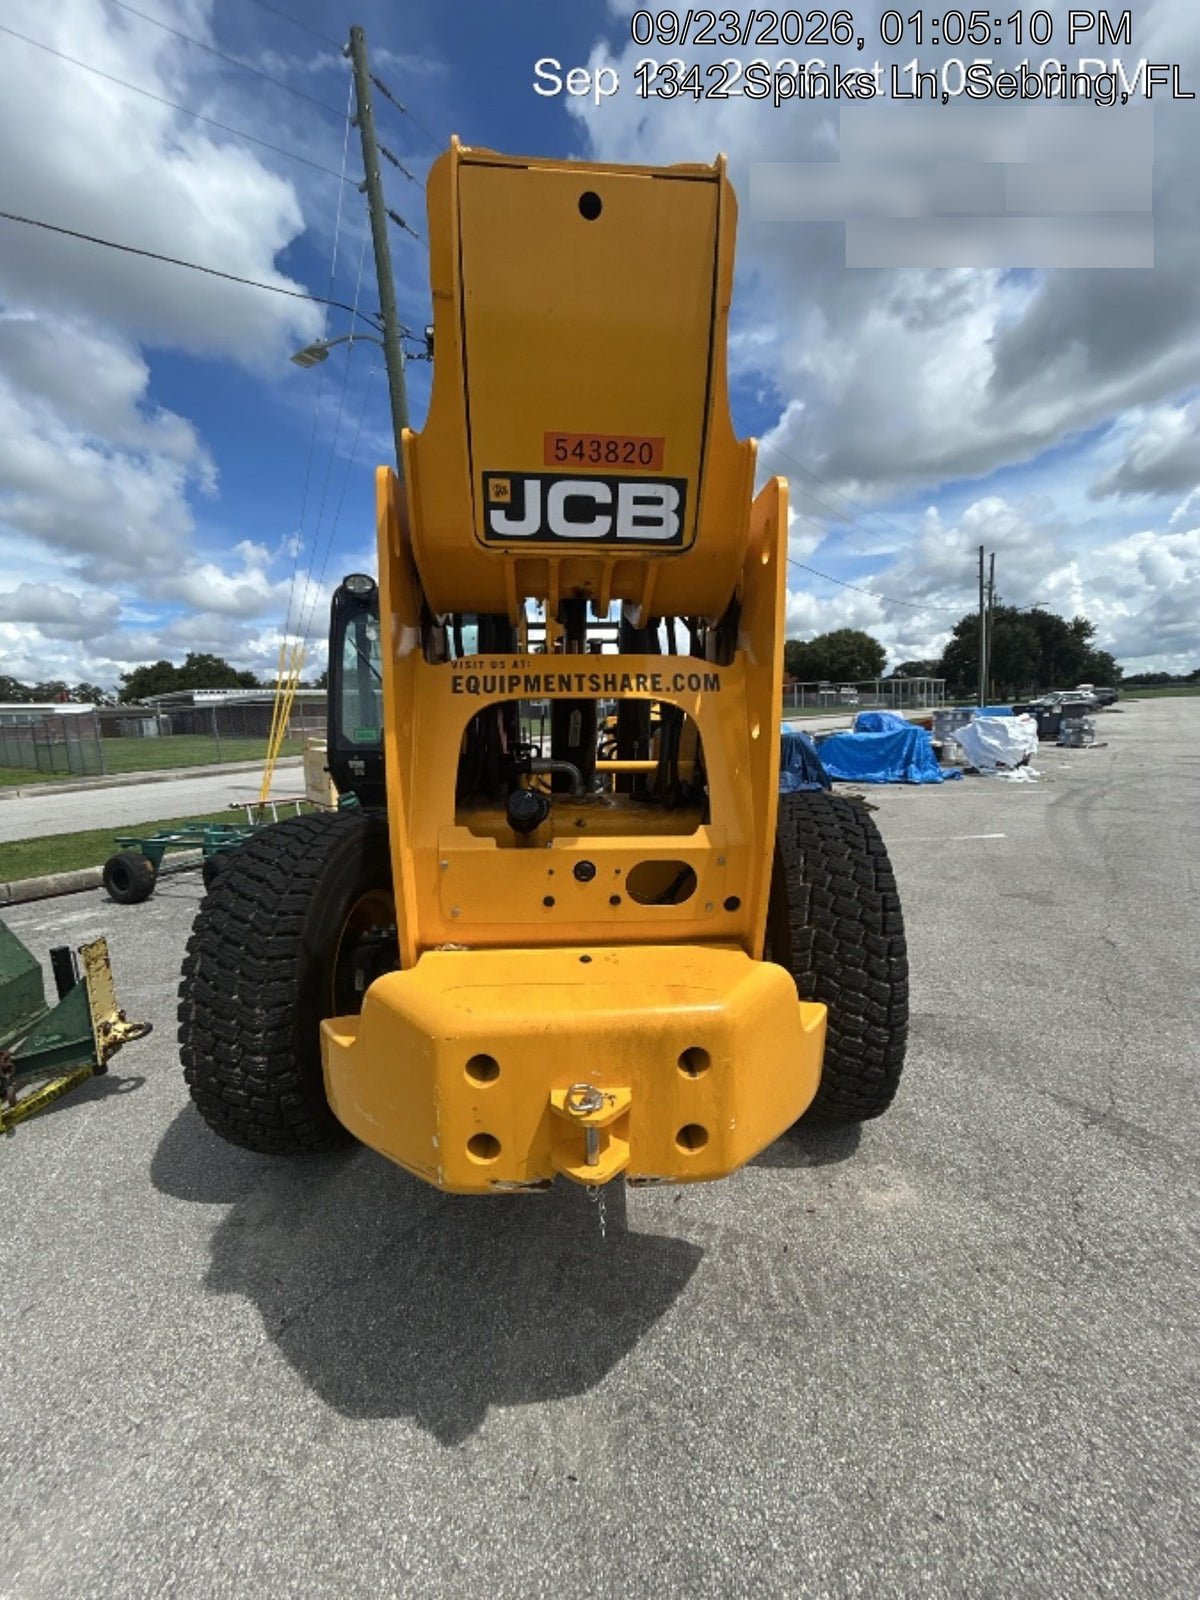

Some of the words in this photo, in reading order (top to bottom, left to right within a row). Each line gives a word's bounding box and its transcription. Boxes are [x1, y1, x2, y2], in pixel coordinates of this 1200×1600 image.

[554, 438, 654, 465] 543820
[489, 479, 681, 540] JCB
[451, 660, 484, 669] VISIT
[490, 660, 506, 669] US
[511, 660, 531, 669] AT:
[450, 673, 721, 696] EQUIPMENTSHARE.COM
